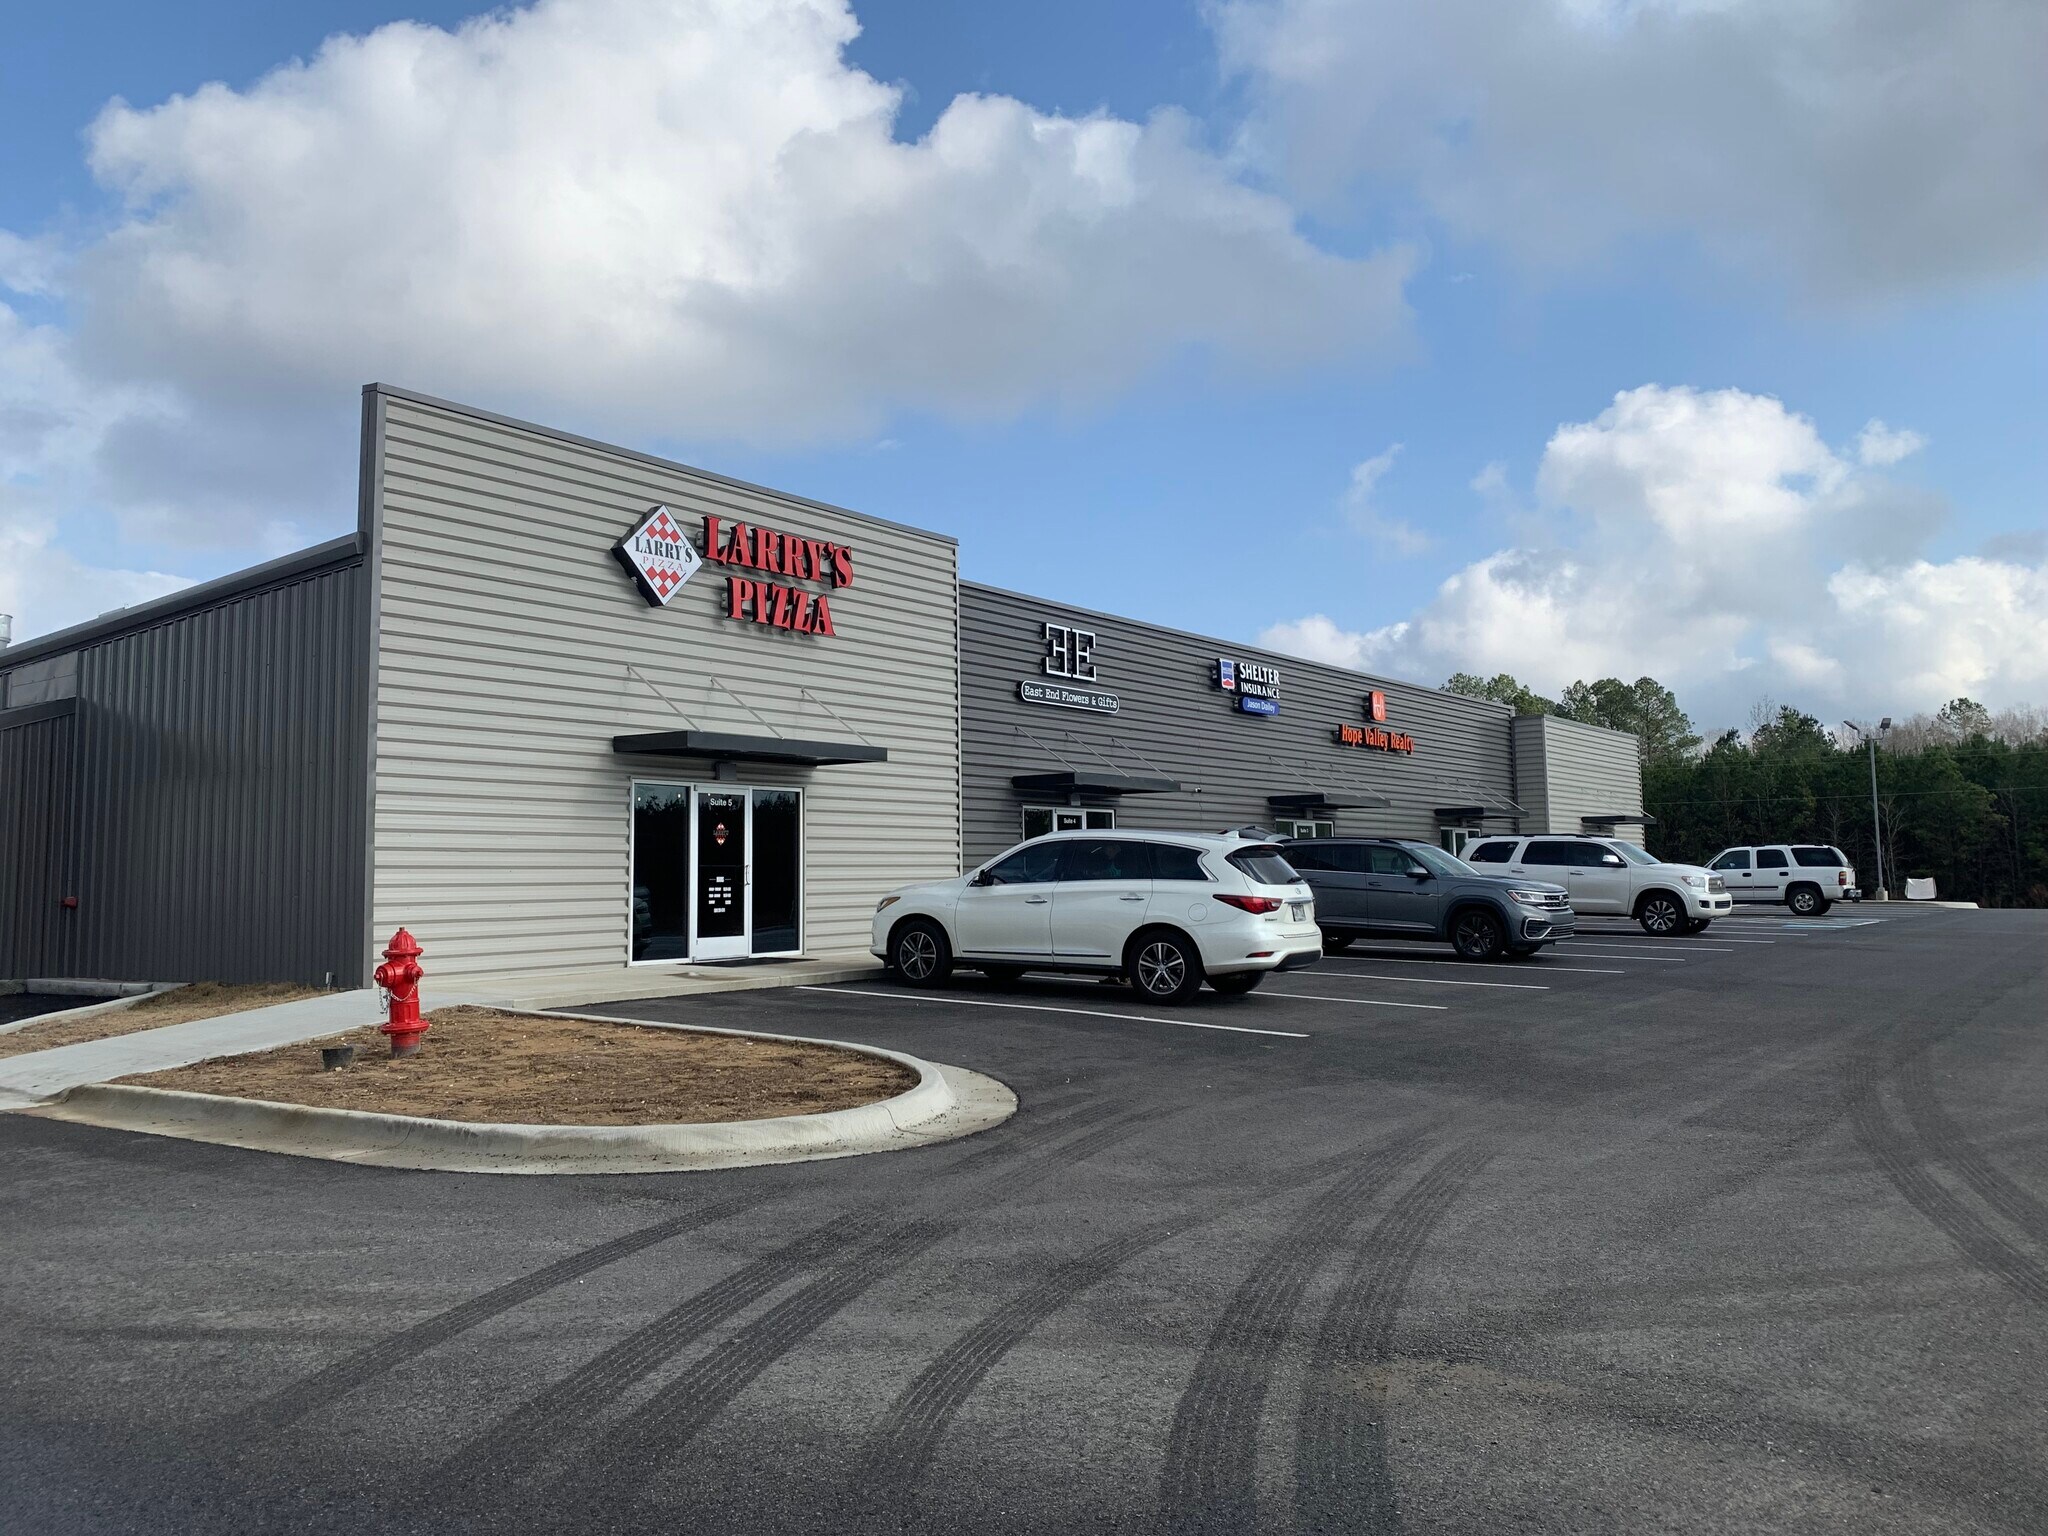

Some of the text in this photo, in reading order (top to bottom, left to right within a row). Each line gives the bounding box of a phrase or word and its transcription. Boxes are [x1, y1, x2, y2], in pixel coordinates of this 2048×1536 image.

[635, 536, 693, 563] LARRY'S
[702, 515, 854, 589] LARRY'S
[643, 556, 683, 572] PIZZA
[726, 577, 836, 636] PIZZA
[1240, 662, 1281, 686] SHELTER
[1024, 685, 1118, 709] East End Flowers & Gifts
[1240, 681, 1281, 699] INSURANCE
[1247, 699, 1261, 710] Jason
[1342, 723, 1415, 753] Hope Valley Realty
[710, 797, 727, 806] Suite
